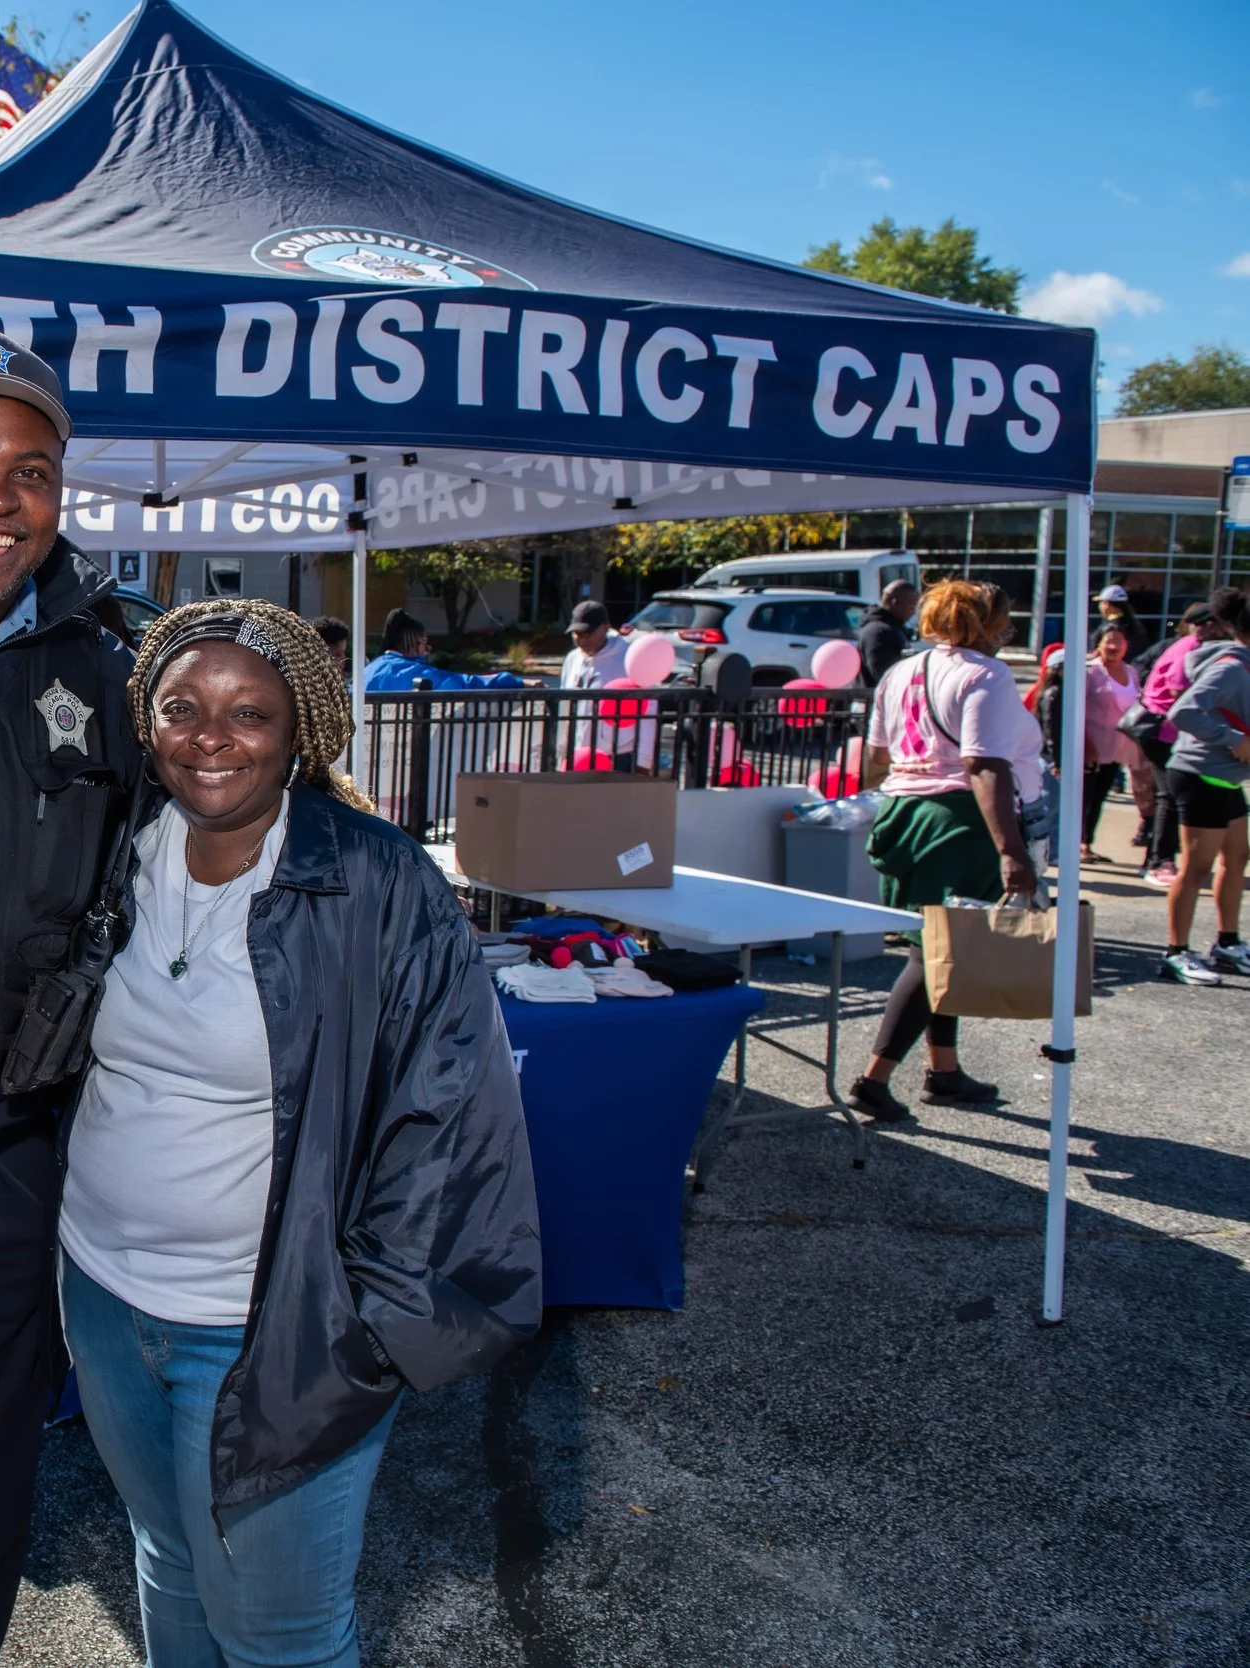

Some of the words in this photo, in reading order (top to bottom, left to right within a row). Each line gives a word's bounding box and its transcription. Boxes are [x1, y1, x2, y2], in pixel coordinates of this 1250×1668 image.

[270, 231, 475, 266] COMMUNITY
[215, 299, 778, 429] DISTRICT
[812, 344, 1063, 454] CAPS
[48, 694, 64, 722] CHICAGO
[67, 697, 84, 724] POLICE
